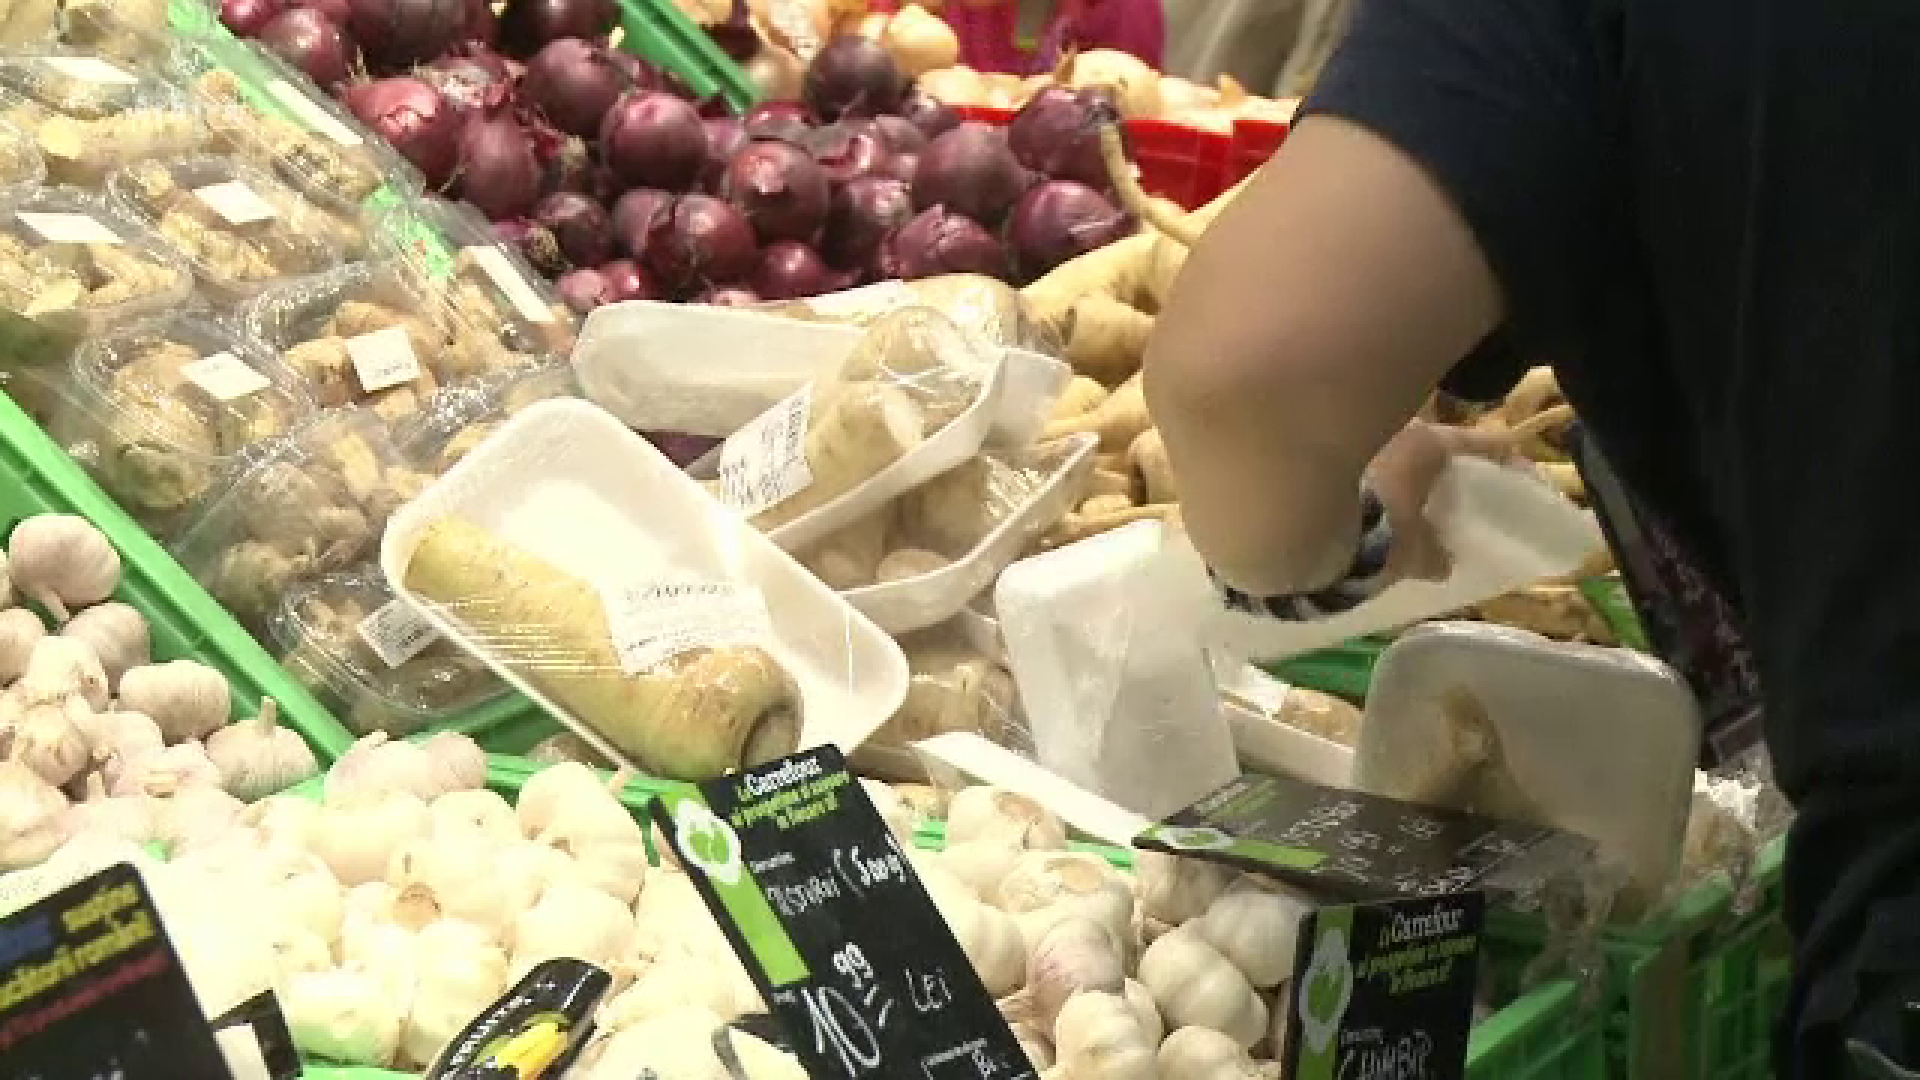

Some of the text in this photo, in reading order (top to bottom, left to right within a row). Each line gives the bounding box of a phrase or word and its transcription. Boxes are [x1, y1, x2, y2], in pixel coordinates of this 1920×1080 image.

[744, 757, 822, 796] Carrefour
[1391, 903, 1465, 943] Carrefour
[832, 941, 874, 988] 99
[800, 985, 880, 1078] 10
